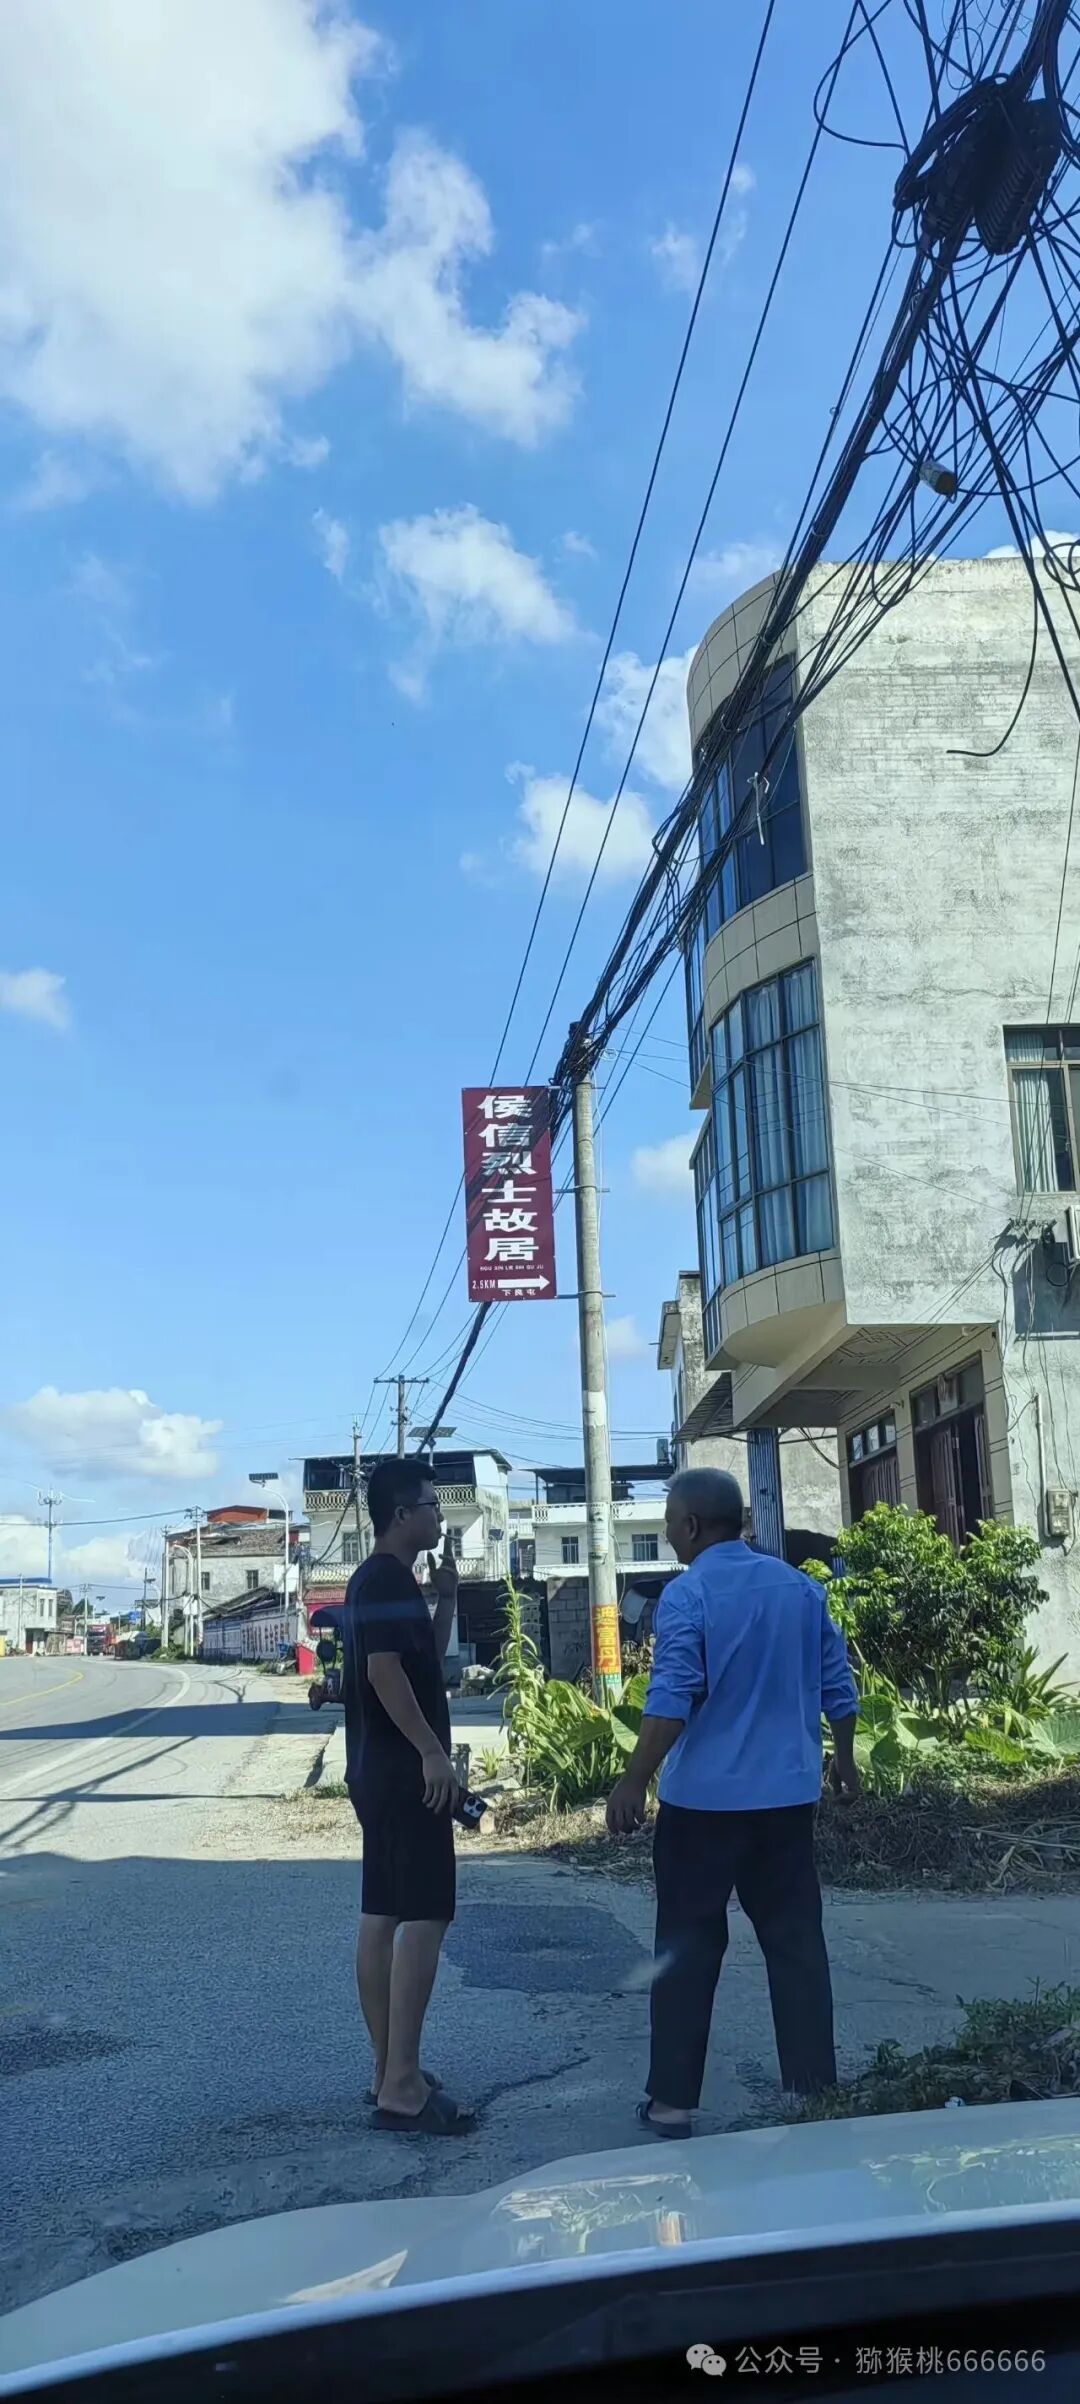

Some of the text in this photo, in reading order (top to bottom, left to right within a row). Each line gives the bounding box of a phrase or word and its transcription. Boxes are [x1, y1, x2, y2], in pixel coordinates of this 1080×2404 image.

[478, 1095, 539, 1261] 侯信烈士故居
[472, 1279, 496, 1289] 2.5KM
